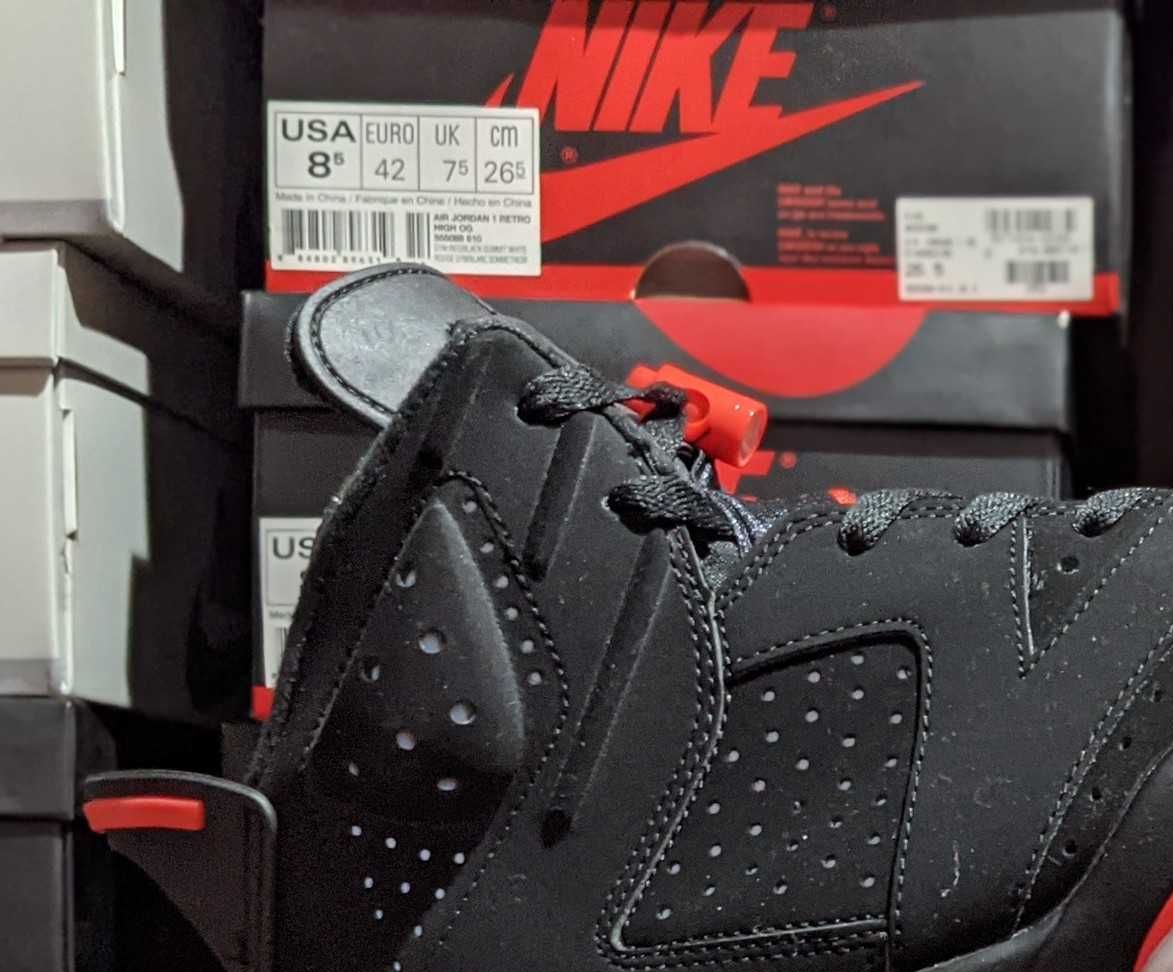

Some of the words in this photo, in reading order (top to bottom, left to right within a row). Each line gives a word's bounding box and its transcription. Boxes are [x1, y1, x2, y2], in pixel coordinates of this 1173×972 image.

[514, 0, 814, 134] NIKE
[281, 118, 356, 143] USA
[365, 122, 414, 145] EURO
[435, 125, 460, 146] UK
[490, 126, 518, 148] cm
[374, 159, 405, 181] 42
[433, 213, 449, 222] AIR
[453, 213, 490, 223] JORDAN
[499, 214, 531, 224] RETRO
[433, 223, 457, 233] HIGH
